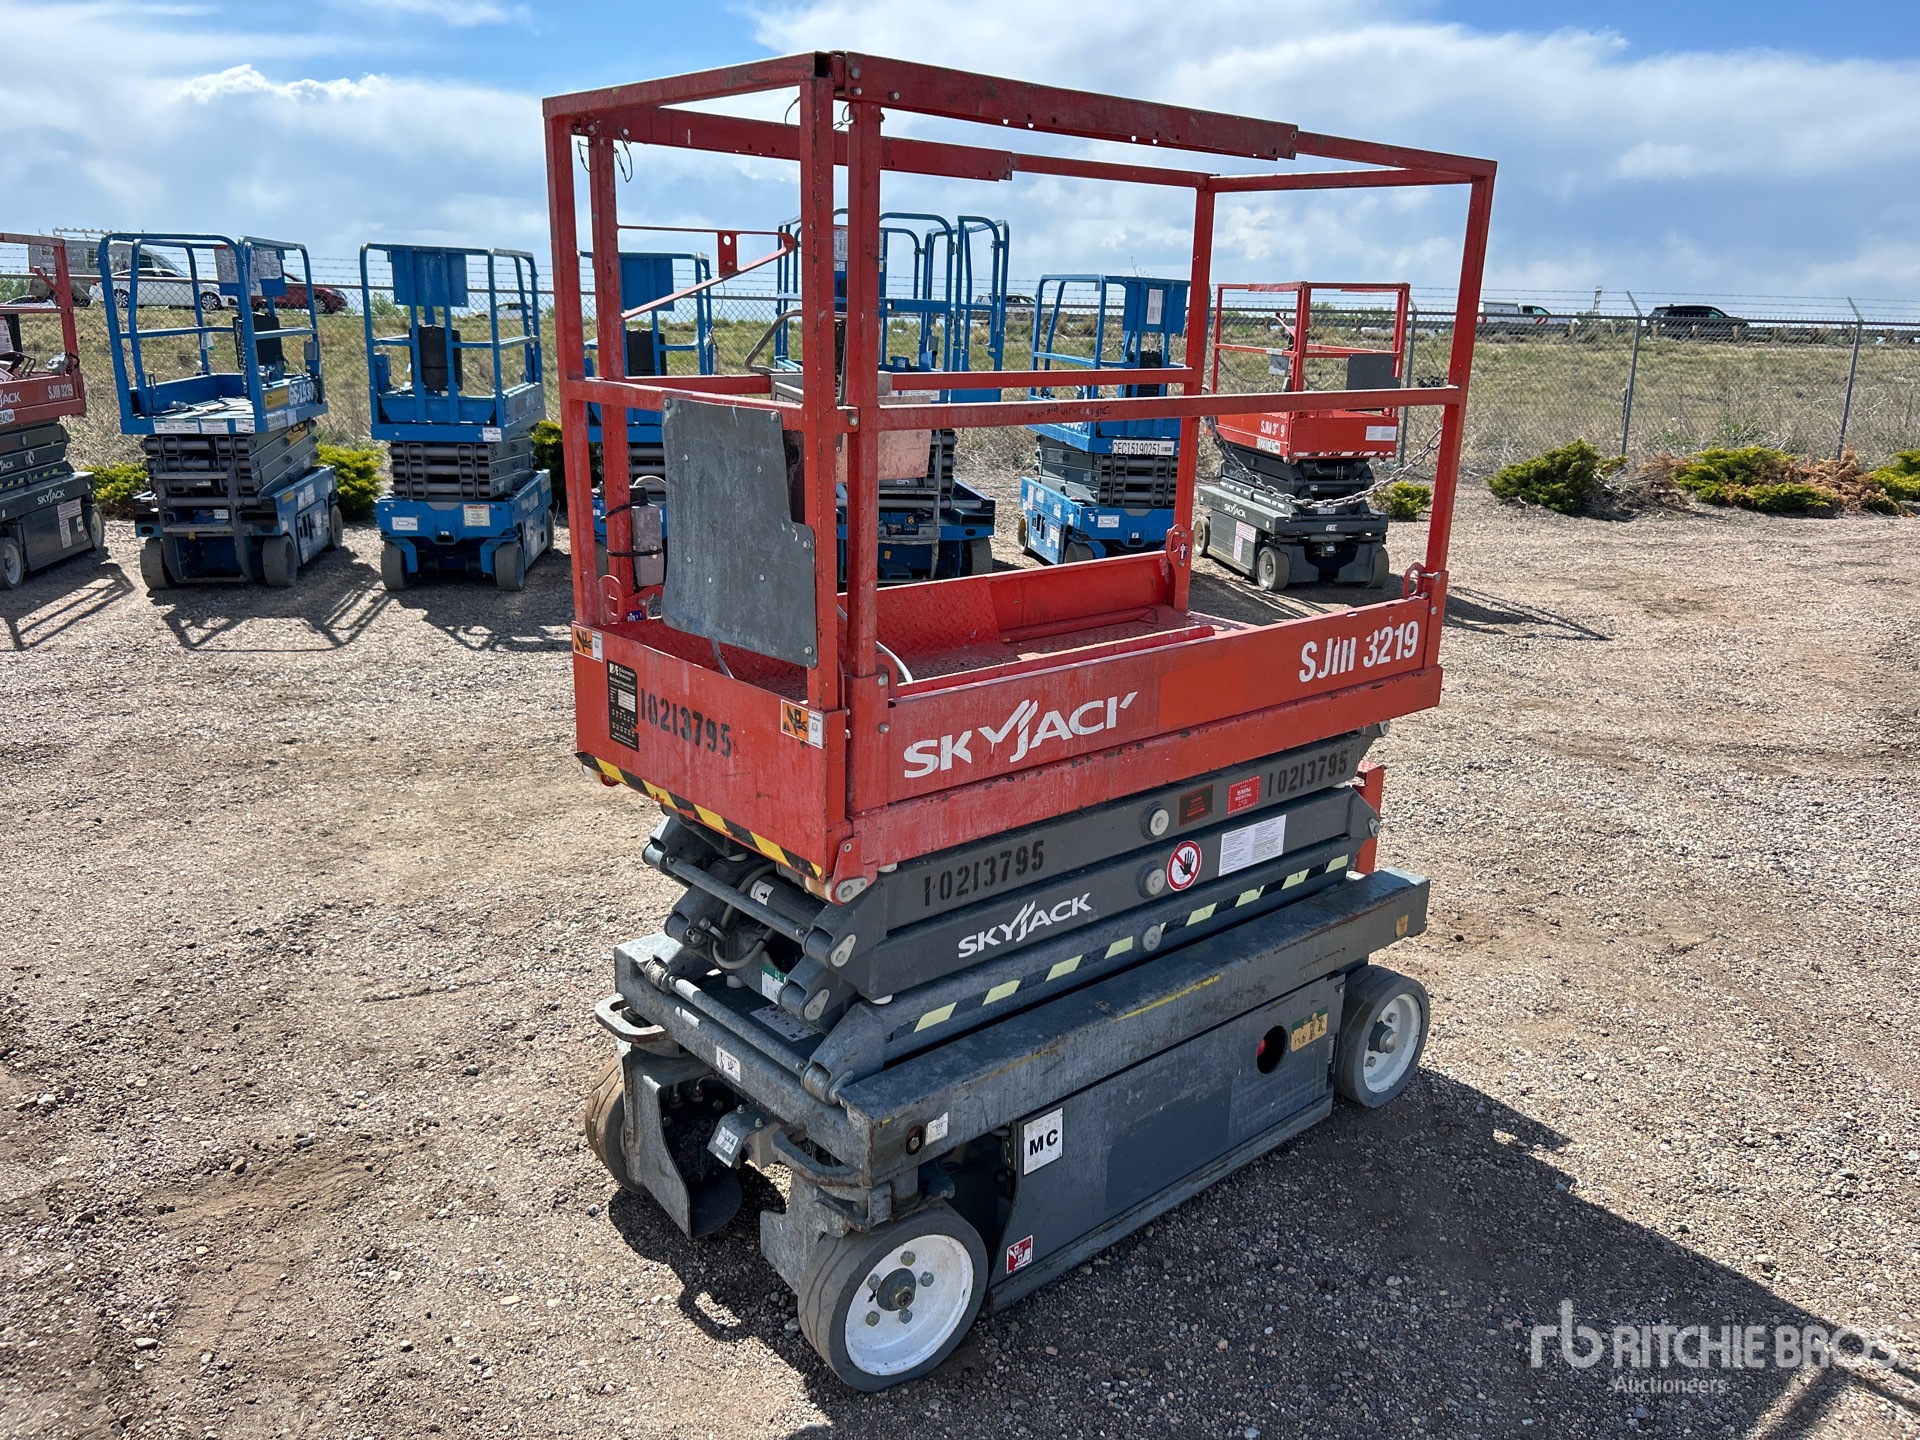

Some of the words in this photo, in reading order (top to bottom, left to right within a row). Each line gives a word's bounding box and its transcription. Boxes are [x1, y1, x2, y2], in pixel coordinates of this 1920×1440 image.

[0, 389, 21, 407] JACK
[37, 488, 65, 505] SKYJACK
[1223, 503, 1247, 519] SKYJACK
[1363, 620, 1419, 668] 3219
[640, 688, 732, 758] 10213795
[1267, 749, 1349, 798] 10213795
[924, 839, 1045, 907] 10213795
[958, 892, 1093, 958] SKYJACK
